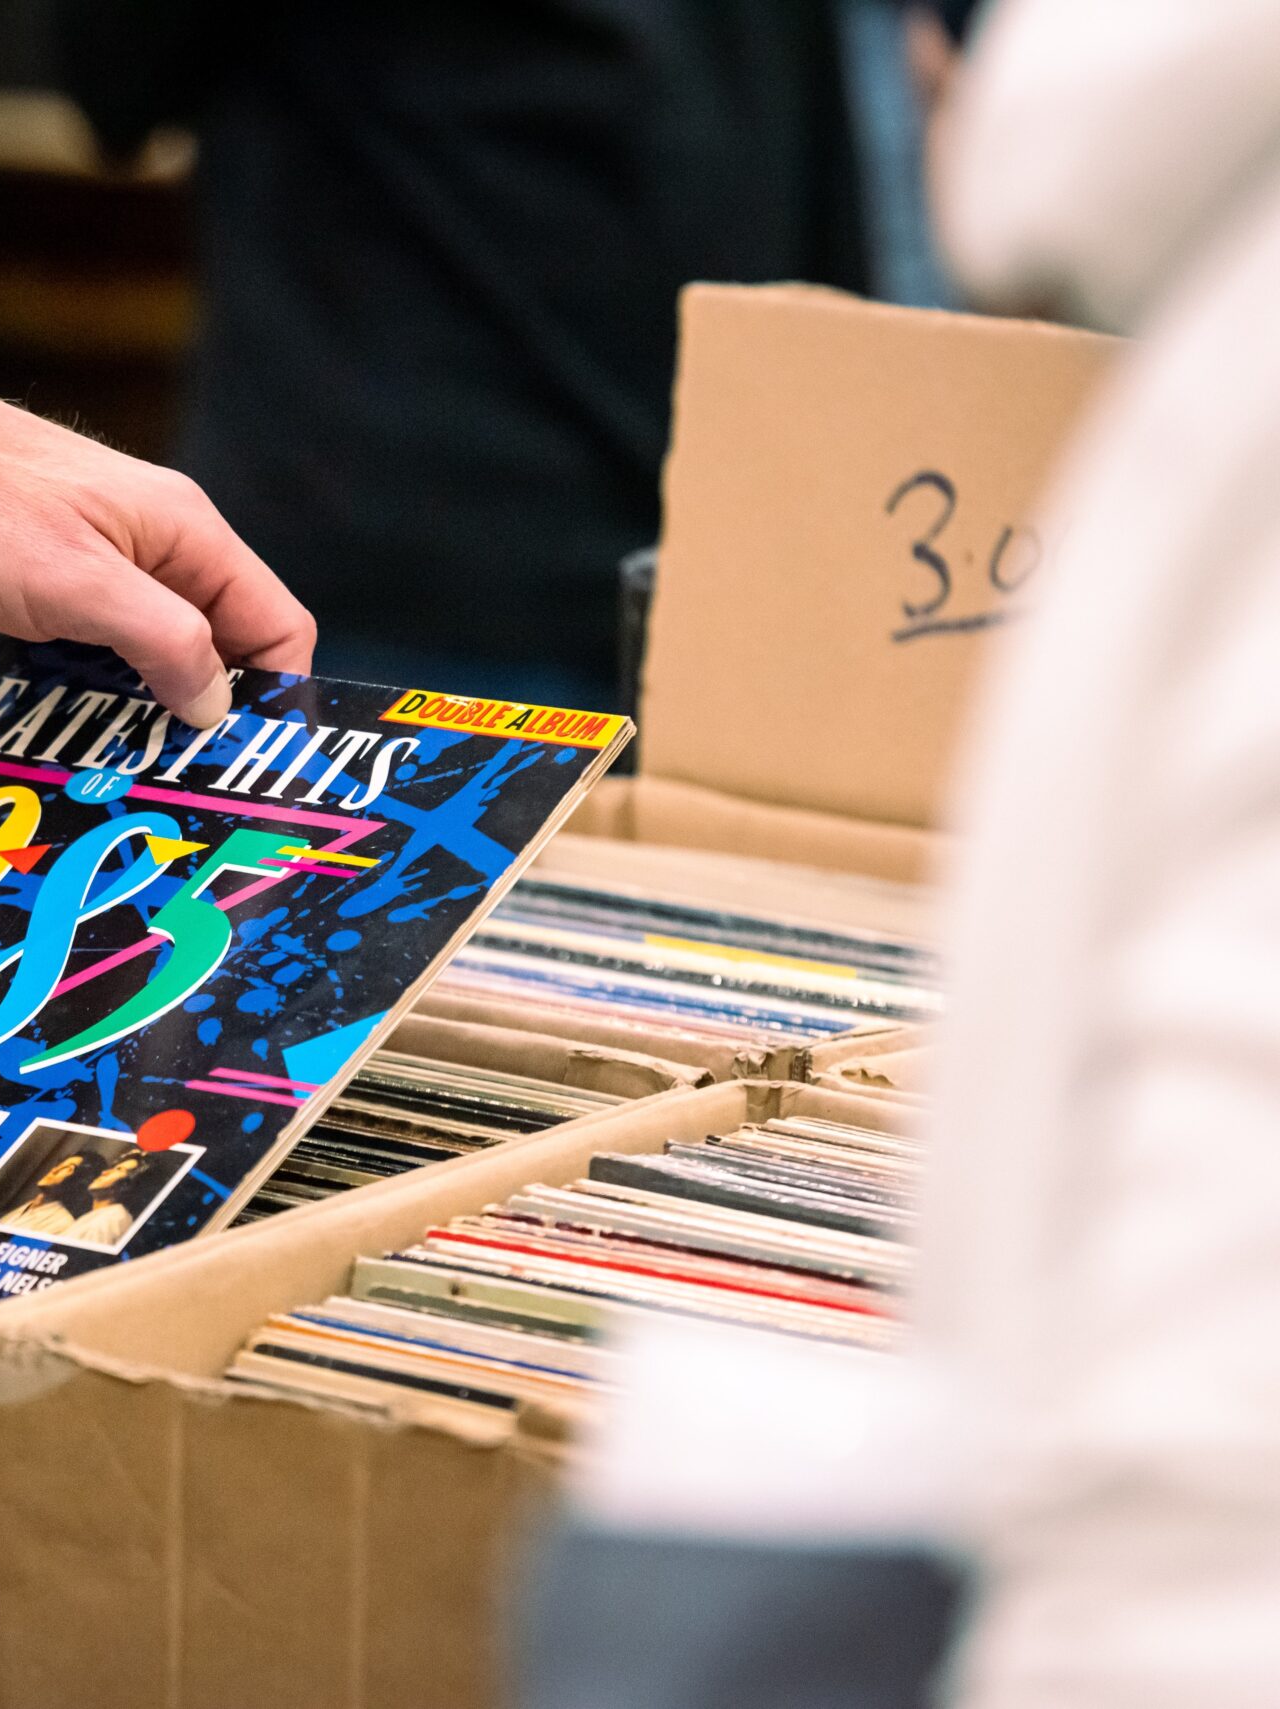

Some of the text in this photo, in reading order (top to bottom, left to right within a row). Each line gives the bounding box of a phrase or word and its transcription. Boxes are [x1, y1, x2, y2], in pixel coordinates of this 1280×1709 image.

[398, 693, 610, 741] DOUBLE ALBUM
[81, 772, 120, 799] OF
[209, 717, 421, 811] HITS
